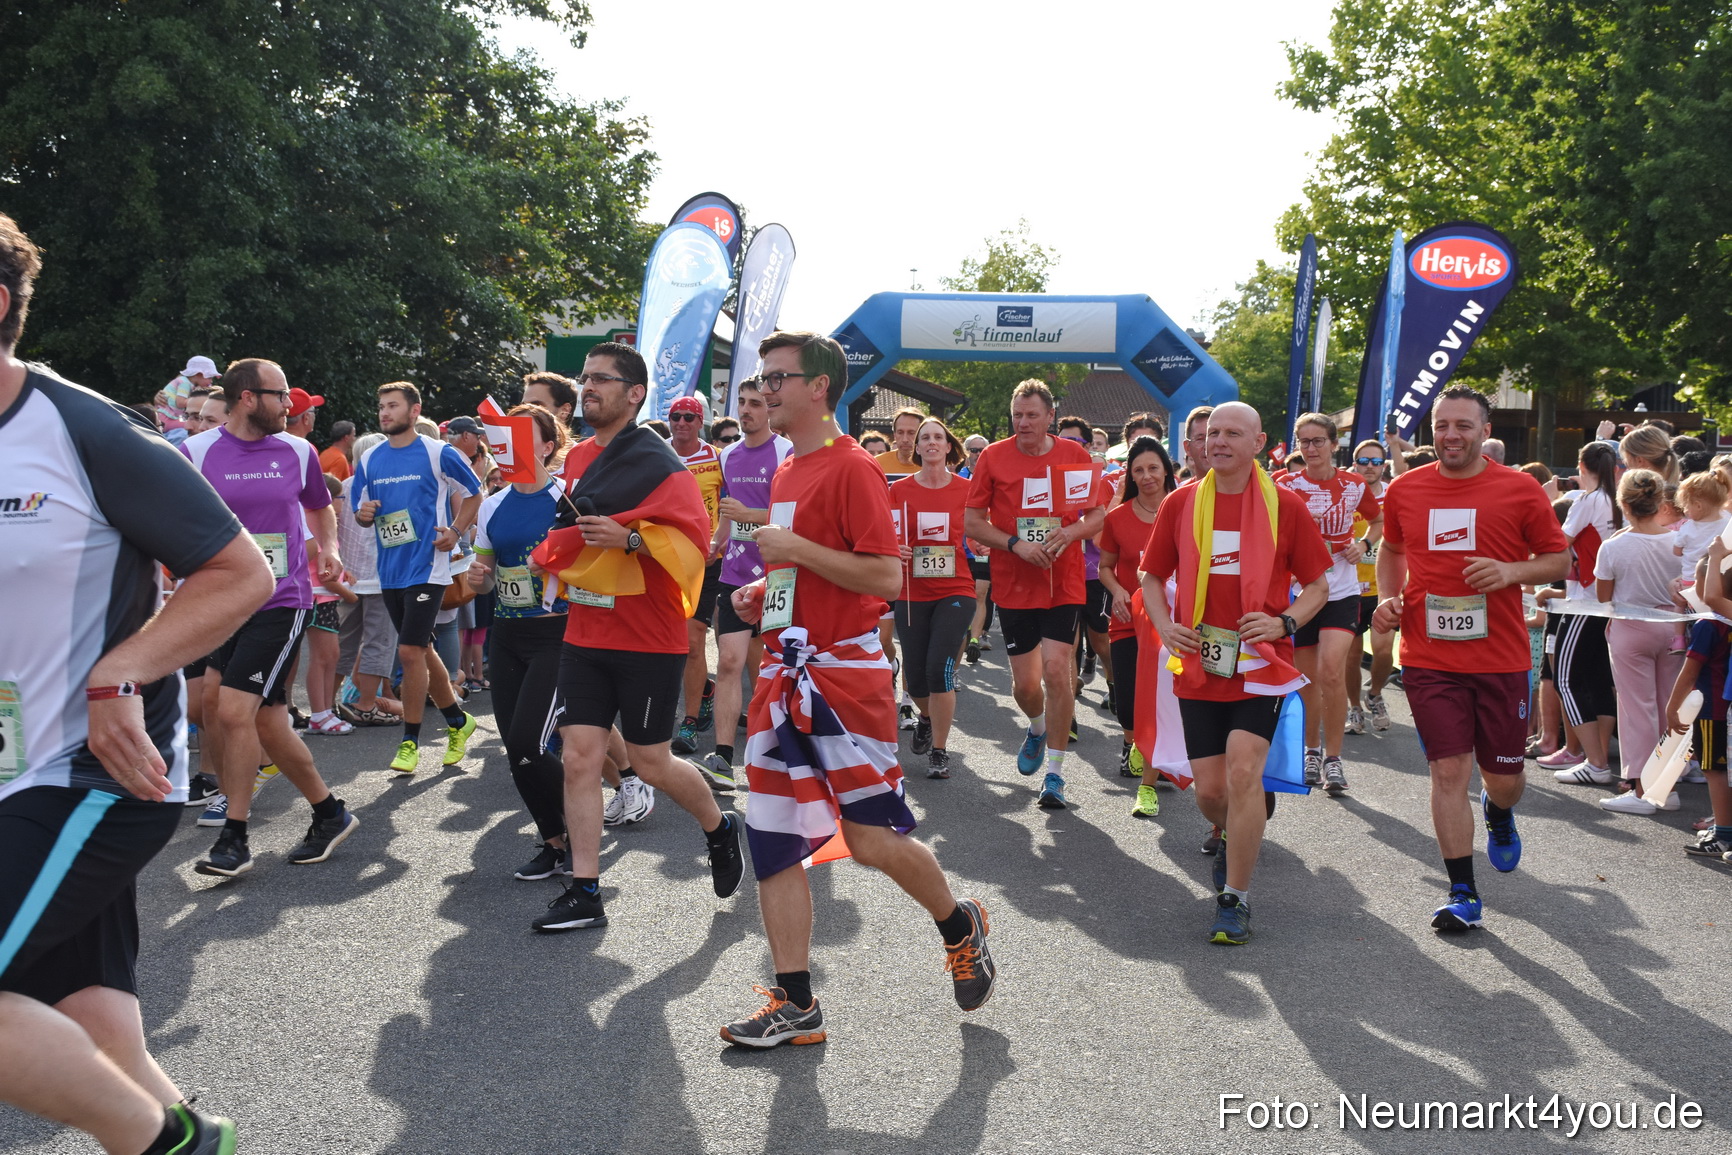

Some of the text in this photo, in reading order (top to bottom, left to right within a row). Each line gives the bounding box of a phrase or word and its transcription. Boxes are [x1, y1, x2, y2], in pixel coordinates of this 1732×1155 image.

[1420, 247, 1501, 279] Hervis
[1430, 273, 1461, 281] SPORTS
[1003, 312, 1031, 321] Fischer
[983, 326, 1063, 343] firmenlauf
[845, 352, 874, 361] scher
[263, 471, 284, 479] LILA.
[373, 474, 421, 485] energiegeladen
[380, 522, 408, 539] 2154
[1443, 532, 1459, 540] DEHN
[922, 557, 946, 569] 513
[1214, 555, 1231, 563] DEHN
[763, 590, 786, 616] 445
[1437, 615, 1474, 631] 9129
